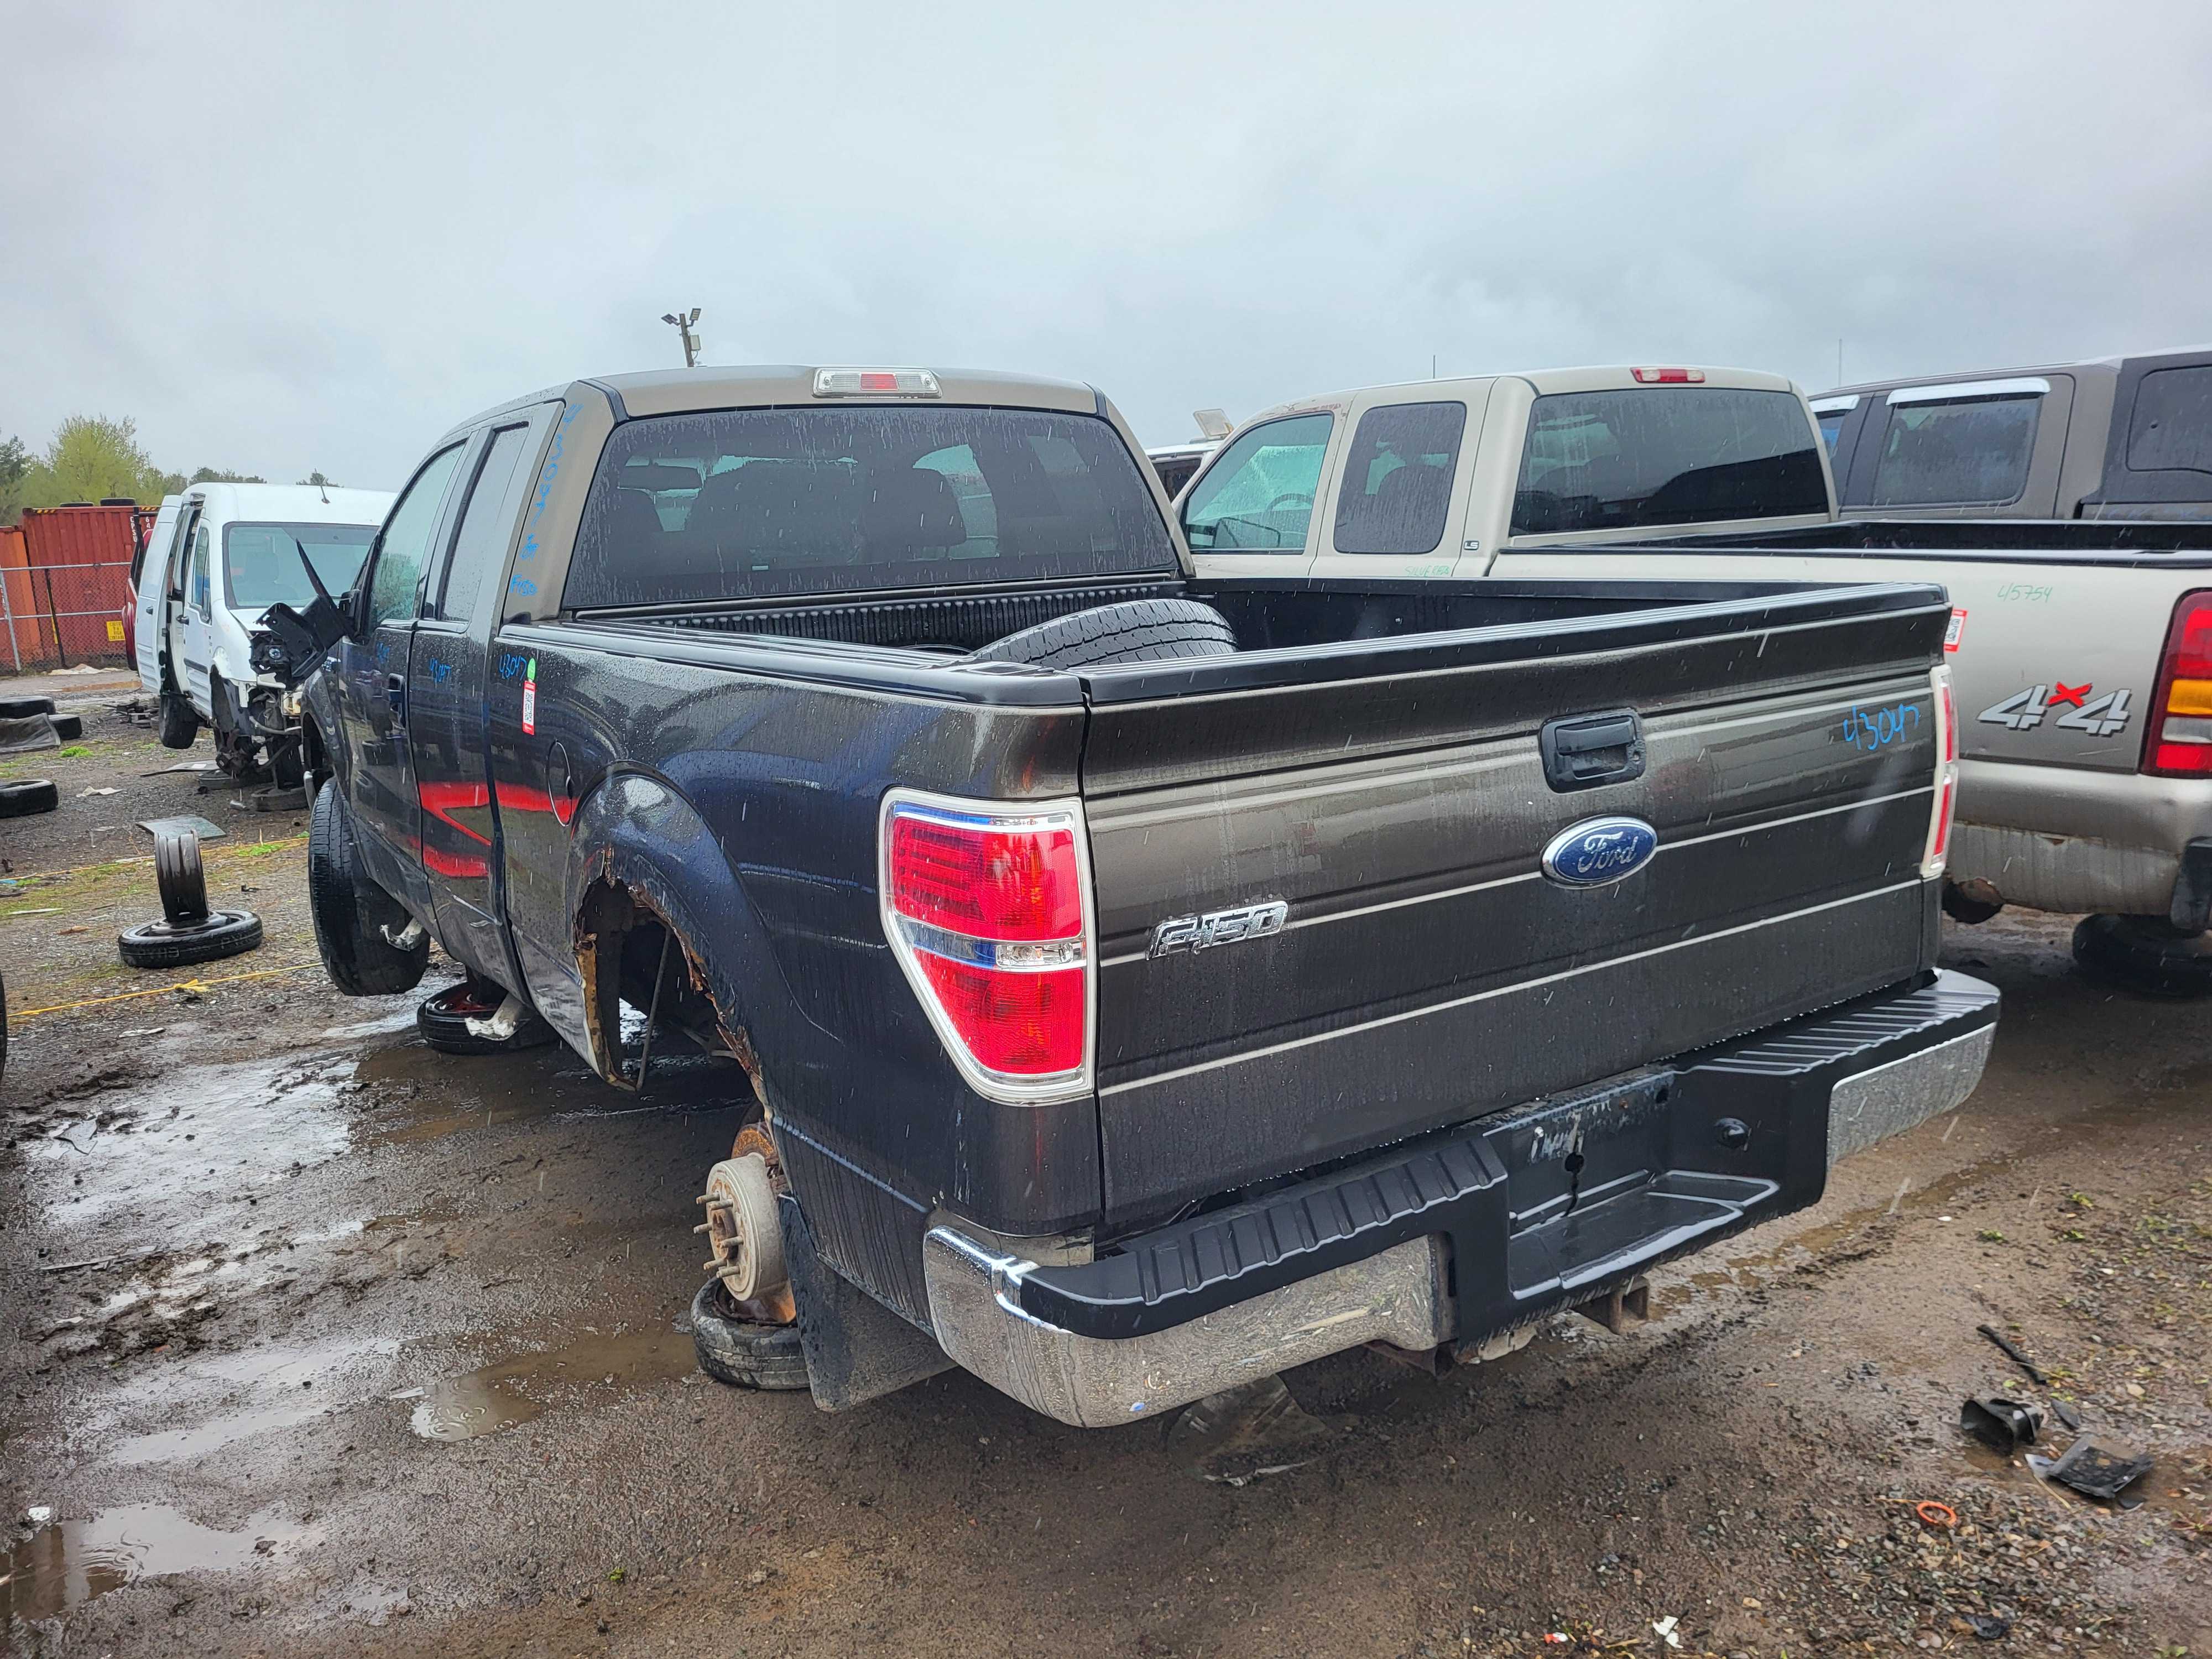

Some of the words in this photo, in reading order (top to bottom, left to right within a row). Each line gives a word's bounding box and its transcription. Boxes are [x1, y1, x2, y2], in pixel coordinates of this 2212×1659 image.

[1997, 582, 2053, 604] 45754
[499, 653, 527, 680] 43047
[1842, 703, 1920, 750] 43047
[1577, 831, 1638, 873] Ford
